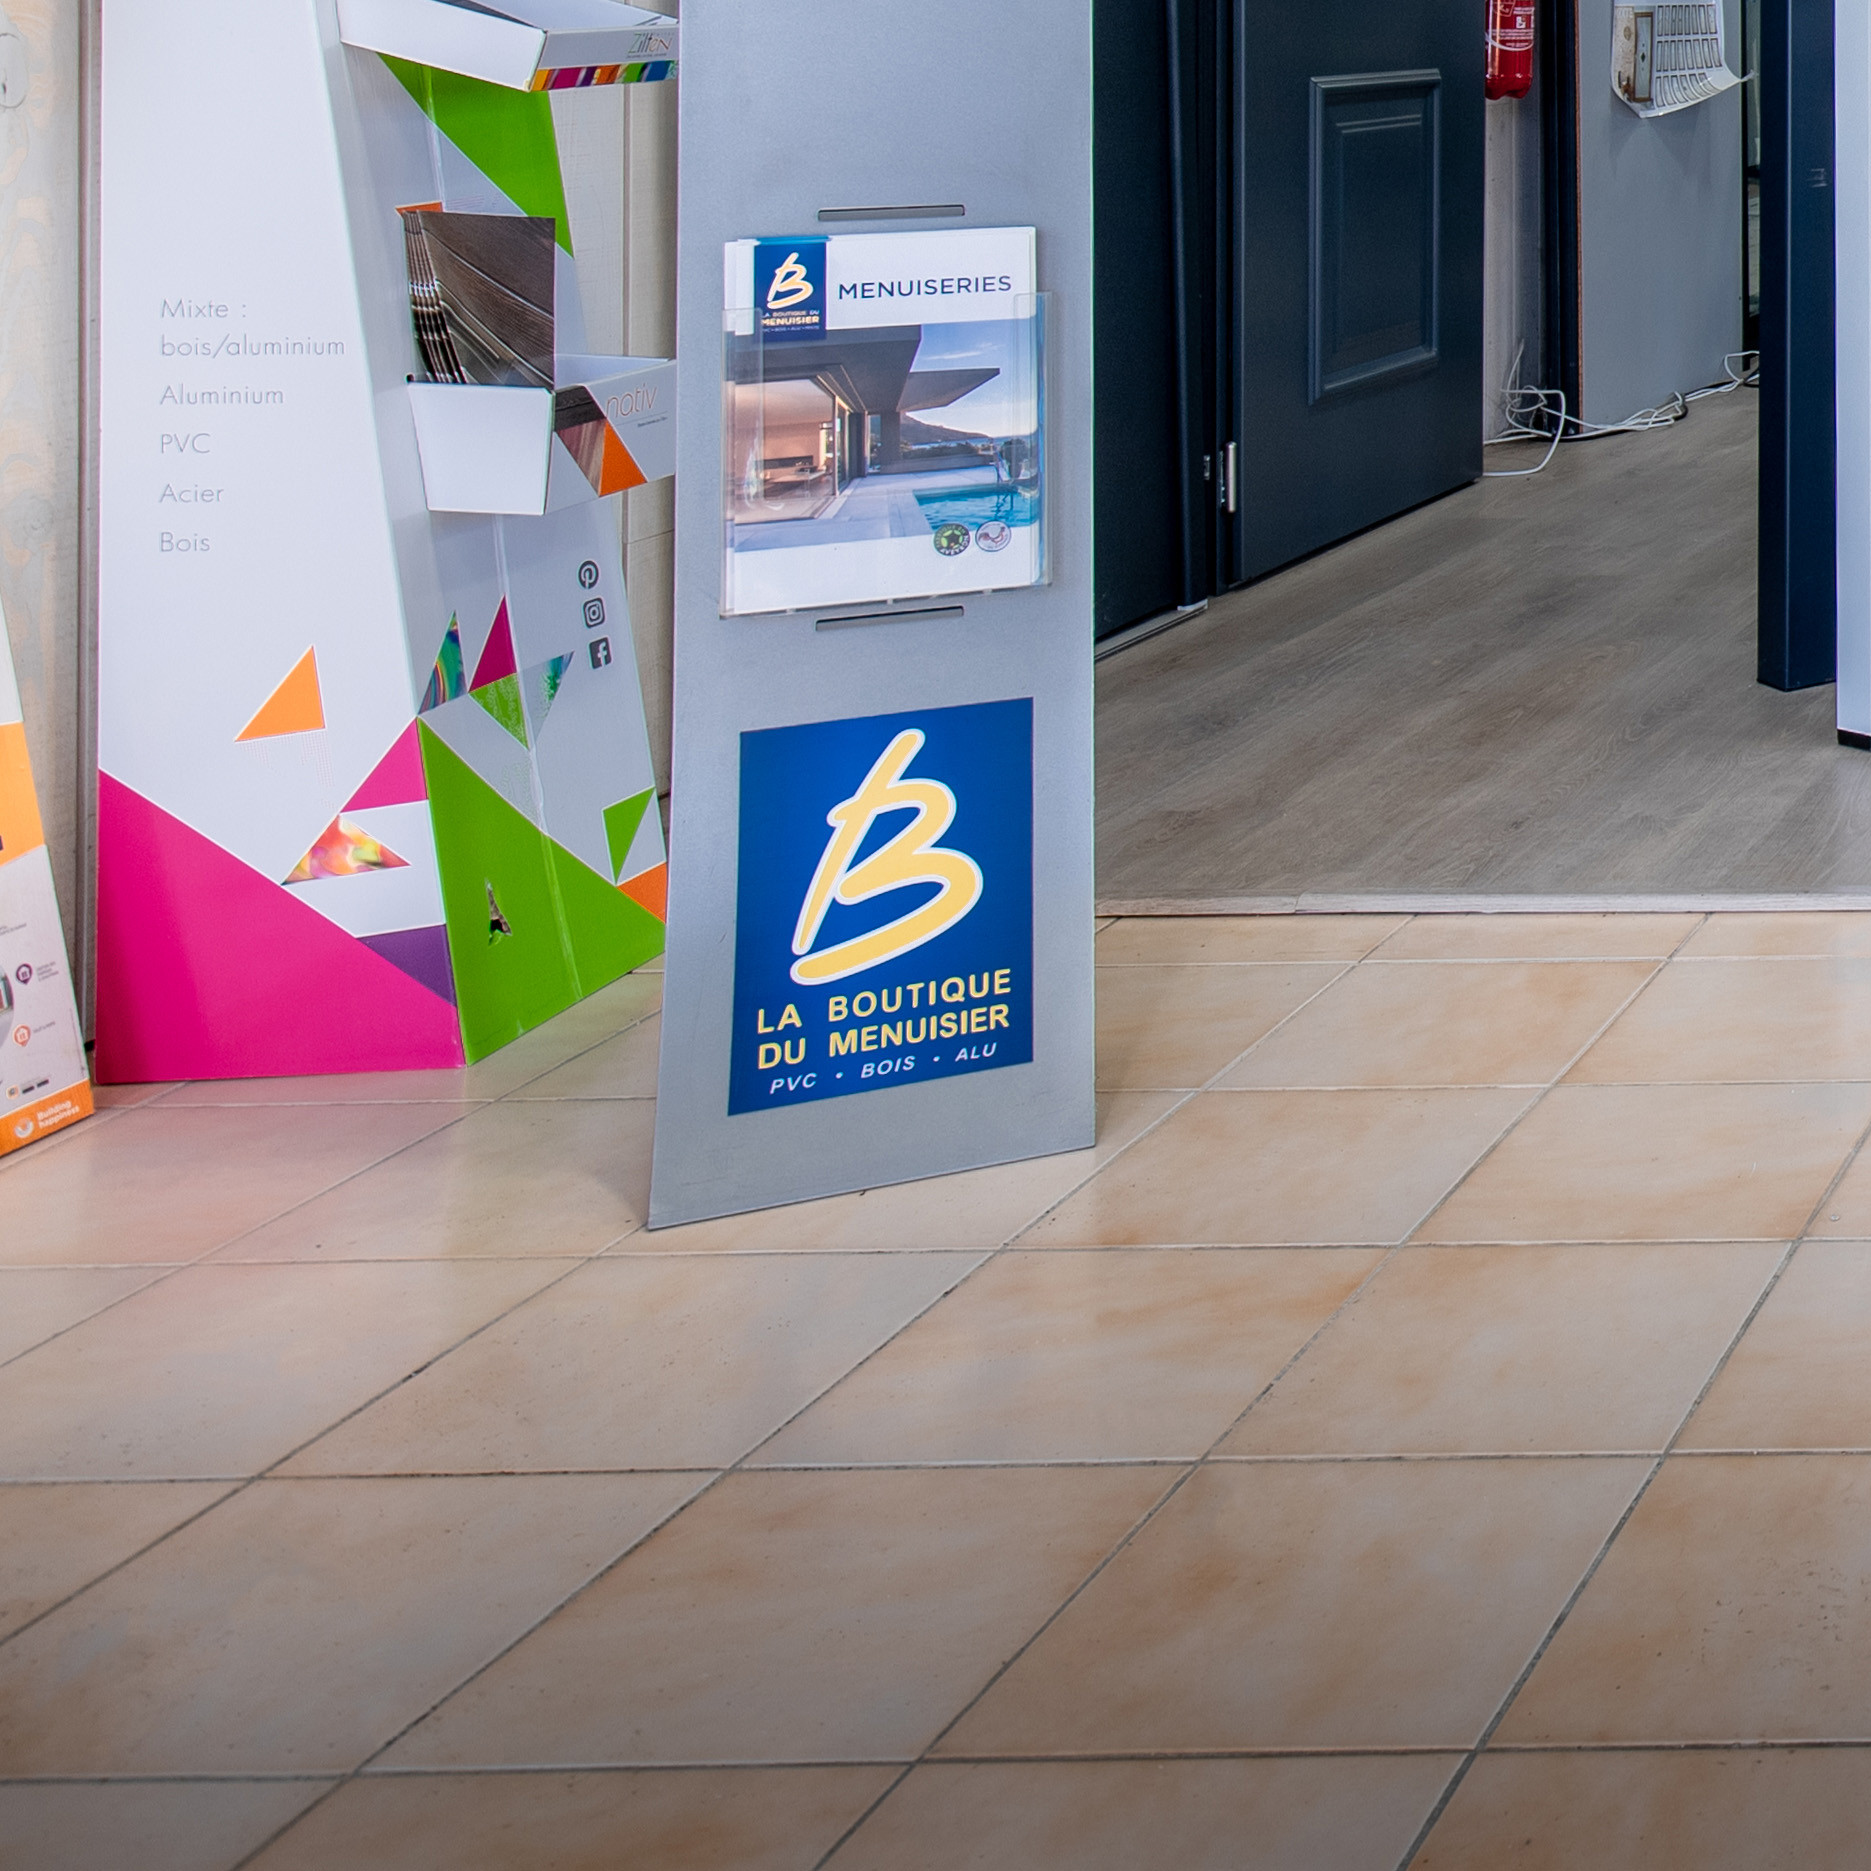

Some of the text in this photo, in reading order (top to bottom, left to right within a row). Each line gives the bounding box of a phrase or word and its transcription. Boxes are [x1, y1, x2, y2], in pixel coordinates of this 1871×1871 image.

[838, 275, 1013, 301] MENUISERIES
[160, 298, 229, 319] Mixte
[762, 316, 820, 326] MENUISIER
[160, 332, 346, 360] bois/aluminium
[159, 383, 285, 406] Aluminium
[160, 432, 212, 455] PVC
[158, 483, 225, 504] Acier
[159, 531, 212, 553] Bois
[756, 967, 1013, 1035] LA BOUTIQUE
[757, 1003, 1011, 1071] DU MENUISIER
[769, 1041, 999, 1096] PVC BOIS ALU
[37, 1100, 72, 1120] Building
[38, 1106, 80, 1129] happiness
